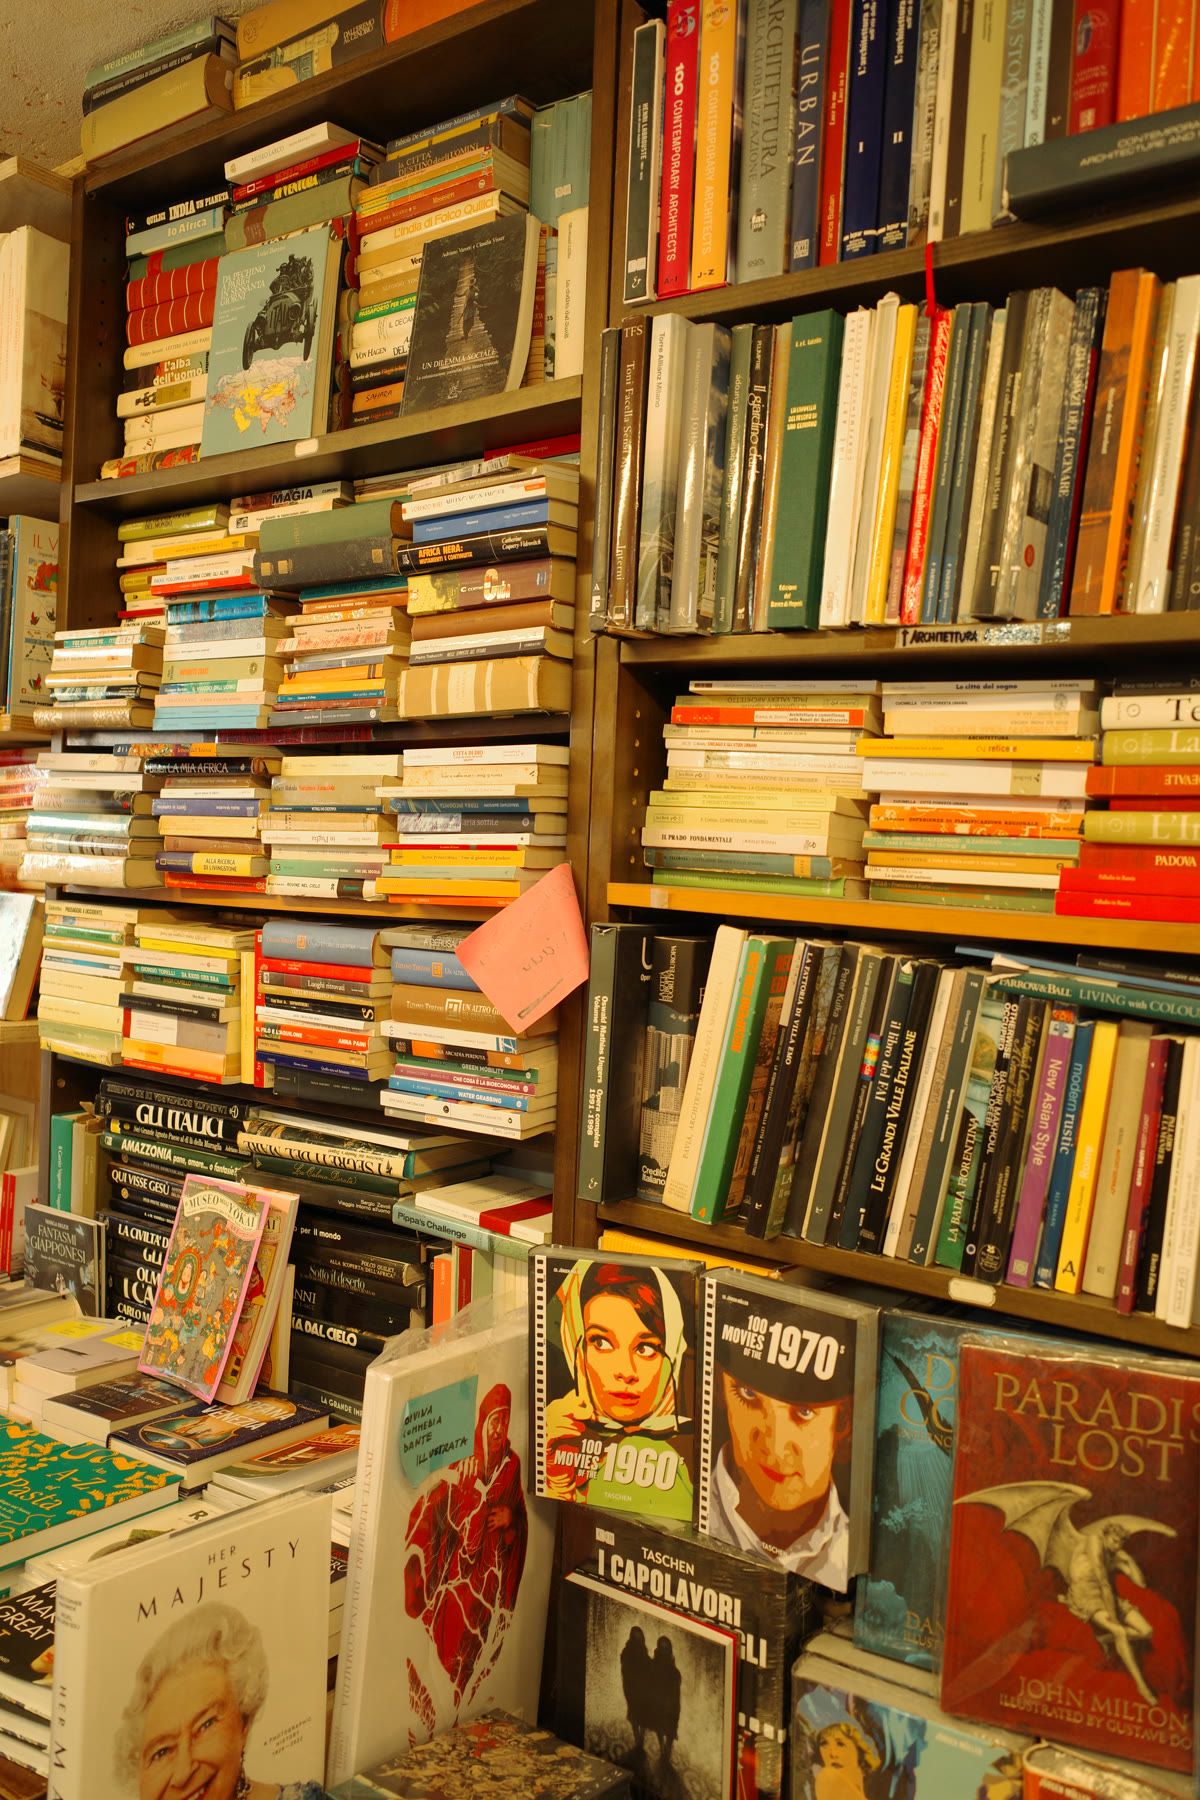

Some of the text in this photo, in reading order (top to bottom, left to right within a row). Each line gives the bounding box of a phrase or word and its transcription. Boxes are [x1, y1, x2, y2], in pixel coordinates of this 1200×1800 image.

[103, 47, 145, 72] weareone
[761, 0, 785, 177] ARCHITETTURA
[796, 43, 820, 166] URBAN
[666, 61, 684, 262] 100 CONTEMPORARY ARCHITECTS
[701, 52, 721, 255] 100 CONTEMPORARY ARCHITECTS
[273, 174, 319, 201] AVVENTURA
[146, 191, 229, 226] QUILICI INDIA UN PIANETA
[394, 196, 495, 240] L'India di Folco Quilici
[623, 324, 643, 338] TFS
[153, 367, 203, 386] dell'uomo
[163, 356, 191, 372] L'alba
[654, 331, 666, 408] Torre Allianz Milano
[365, 389, 393, 402] SAHARA
[623, 360, 635, 423] Toni Facella
[272, 488, 314, 505] MAGIA
[418, 543, 463, 559] AFRICA NERA:
[616, 544, 626, 581] Interni
[910, 629, 978, 644] ARCHITETTURA
[167, 762, 228, 773] LA MIA AFRICA
[668, 834, 687, 842] PRADO
[689, 835, 733, 844] FONDAMENTALE
[217, 858, 235, 866] RICERCA
[1155, 855, 1197, 868] PADOVA
[307, 979, 346, 991] Luoghi ritrovati
[832, 967, 850, 1018] Peter Kulka
[999, 978, 1148, 1010] FARROW&BALL LIVING with
[462, 1003, 489, 1014] UN ALTRO
[730, 951, 761, 1053] RECUPERO EDILIZIO
[785, 952, 813, 1065] LA FATTORIA DI VILLA EMO
[597, 995, 609, 1083] Oswald Mathias Ungers
[997, 1002, 1012, 1051] OCCUPIED
[1002, 1003, 1019, 1060] OTHERWISE
[338, 1038, 367, 1048] ANNA PAINI
[461, 1063, 504, 1075] GREEN MOBILITY
[874, 1020, 900, 1102] il libro del FAI
[463, 1077, 477, 1085] COSA
[482, 1078, 490, 1086] LA
[490, 1079, 520, 1091] BIOECONOMIA
[458, 1091, 502, 1104] WATER GRABBING
[1059, 1062, 1084, 1155] modern rustic
[136, 1103, 224, 1139] GLI ITALICI
[587, 1088, 597, 1136] 1991-1998
[593, 1089, 604, 1148] Opera completa
[870, 1029, 917, 1193] LE GRANDI VILLE ITALIANE
[986, 1071, 1008, 1155] BASHIR MAKHOUL
[1032, 1059, 1063, 1167] New Asian Style
[111, 1169, 170, 1195] QUI VISSE GESÙ
[641, 1165, 667, 1177] Credito
[947, 1116, 980, 1243] LA BADIA FIORENTINA
[188, 1191, 220, 1208] MUSEO
[698, 1208, 706, 1218] 4
[37, 1223, 77, 1247] FANTASMI
[118, 1224, 162, 1248] LA CIVILTA'
[300, 1226, 312, 1237] per
[319, 1228, 341, 1241] mondo
[397, 1212, 467, 1241] Pippa's Challenge
[30, 1236, 86, 1265] GIAPPONESI
[309, 1264, 366, 1290] Sotto il deserto
[117, 1302, 140, 1320] CARLO
[304, 1318, 358, 1348] DAL CIELO
[721, 1323, 766, 1352] MOVIES
[747, 1314, 769, 1335] 100
[743, 1347, 762, 1361] OF THE
[201, 1404, 267, 1431] VENEZIA
[320, 1396, 352, 1413] LA GRANDE
[404, 1404, 433, 1426] DIVINA
[402, 1415, 442, 1438] COMMEDIA
[403, 1431, 433, 1454] DANTE
[416, 1436, 469, 1467] ILLUSTRATA
[581, 1438, 603, 1456] 100
[1050, 1424, 1185, 1483] LOST
[553, 1449, 600, 1472] MOVIES
[45, 1468, 107, 1491] A-Z
[577, 1469, 598, 1480] OF THE
[0, 1477, 63, 1511] Pasta
[603, 1490, 632, 1502] TASCHEN
[208, 1545, 237, 1565] HER
[641, 1546, 695, 1576] TASCHEN
[761, 1541, 790, 1557] TASCHEN
[136, 1538, 300, 1623] MAJESTY
[597, 1548, 742, 1628] I CAPOLAVORI
[1018, 1675, 1190, 1734] JOHN MILTON
[999, 1694, 1167, 1745] ILLUSTRATED BY GUSTAVE
